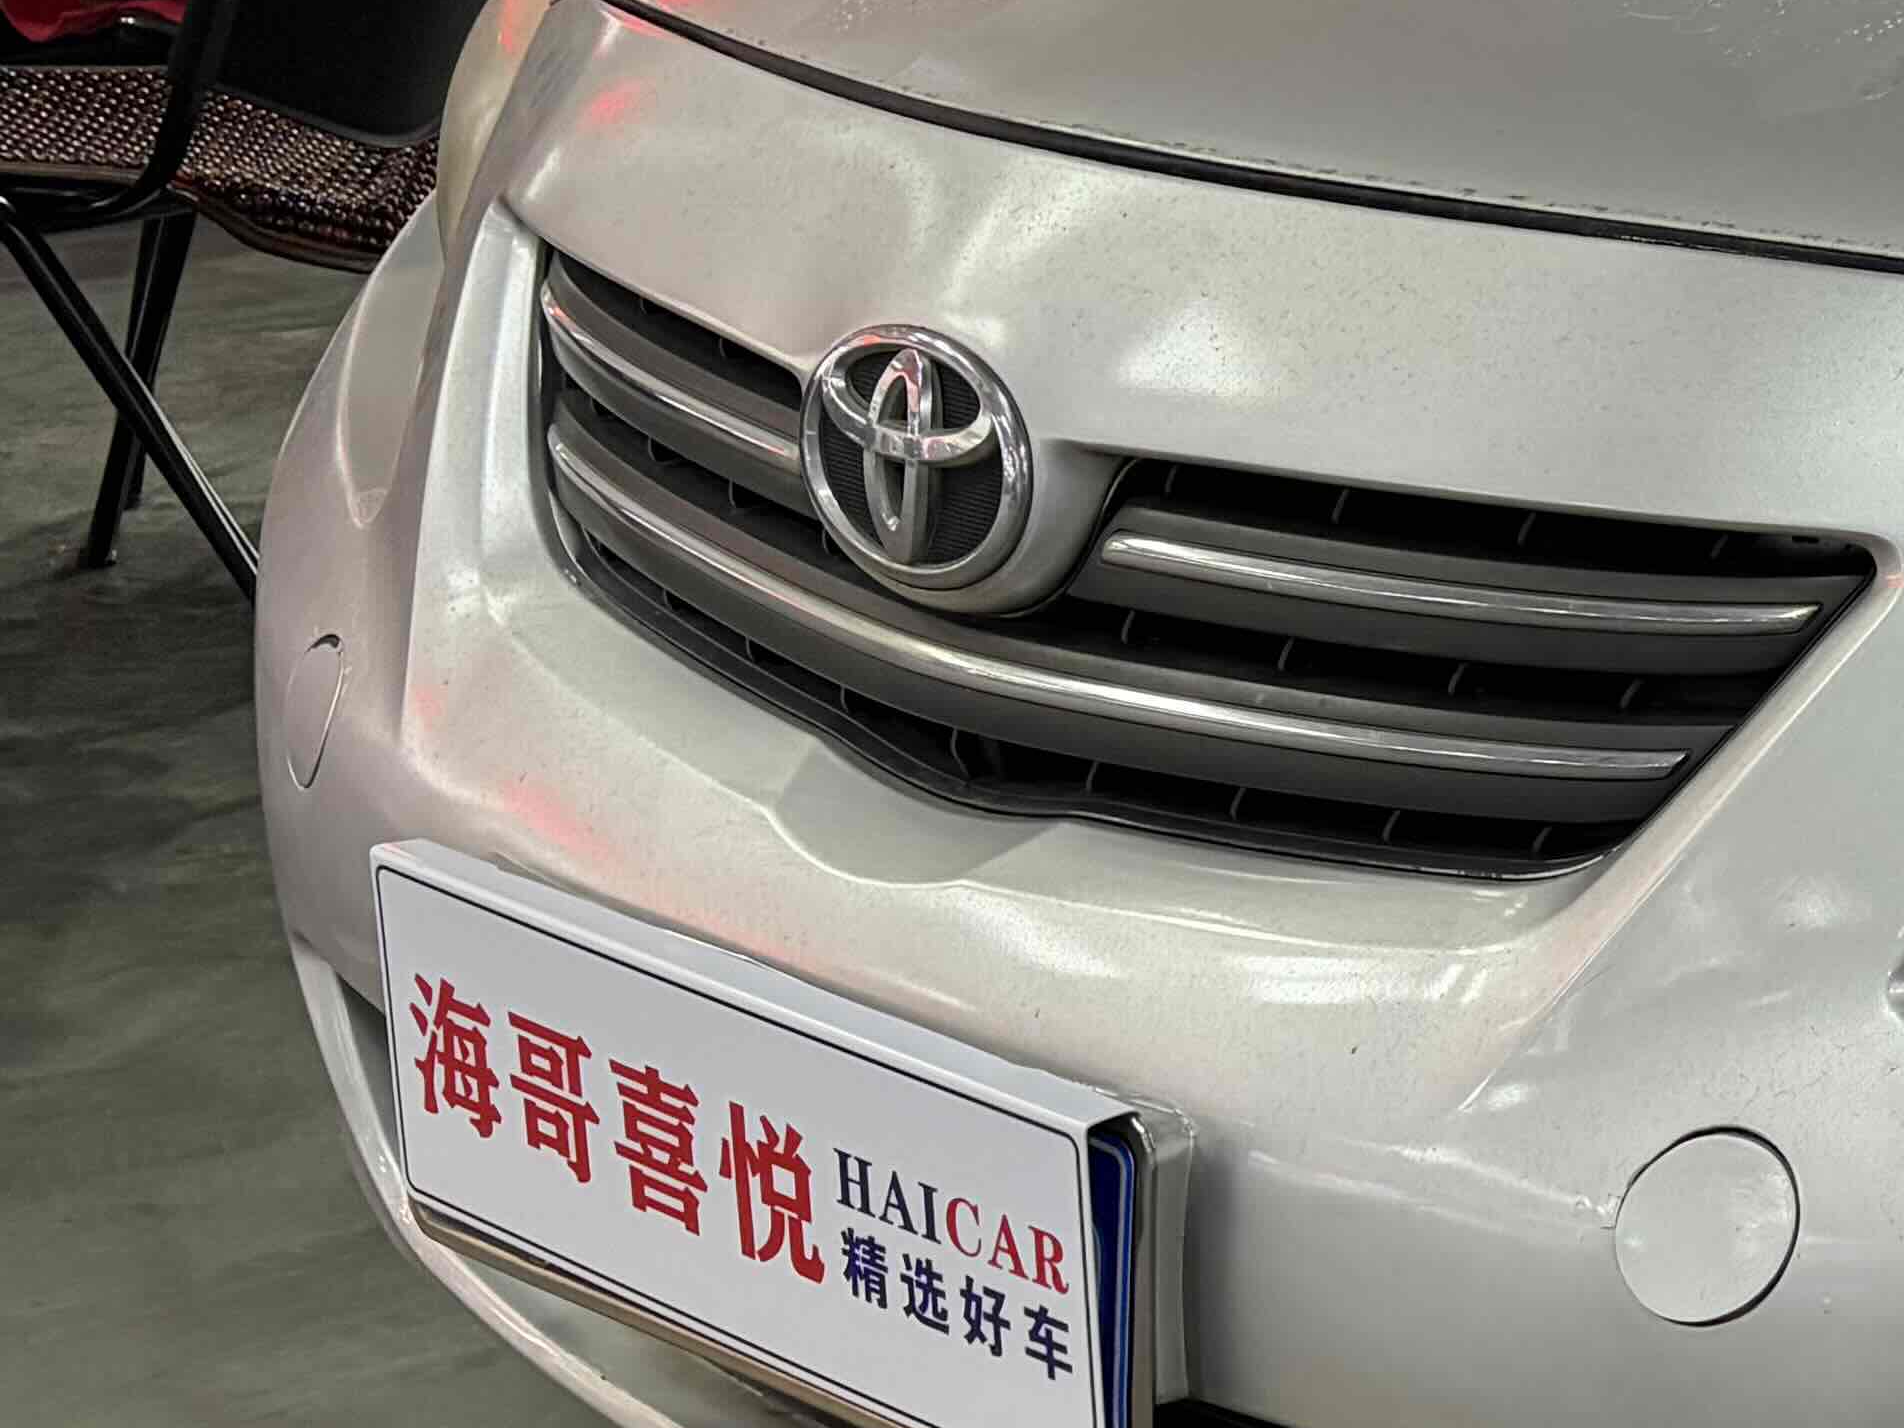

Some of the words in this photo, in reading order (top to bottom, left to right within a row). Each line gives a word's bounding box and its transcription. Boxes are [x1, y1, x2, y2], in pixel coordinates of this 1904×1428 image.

[409, 972, 827, 1285] 海哥喜悦
[834, 1147, 1070, 1296] HAICAR
[839, 1227, 1075, 1382] 精选好车
